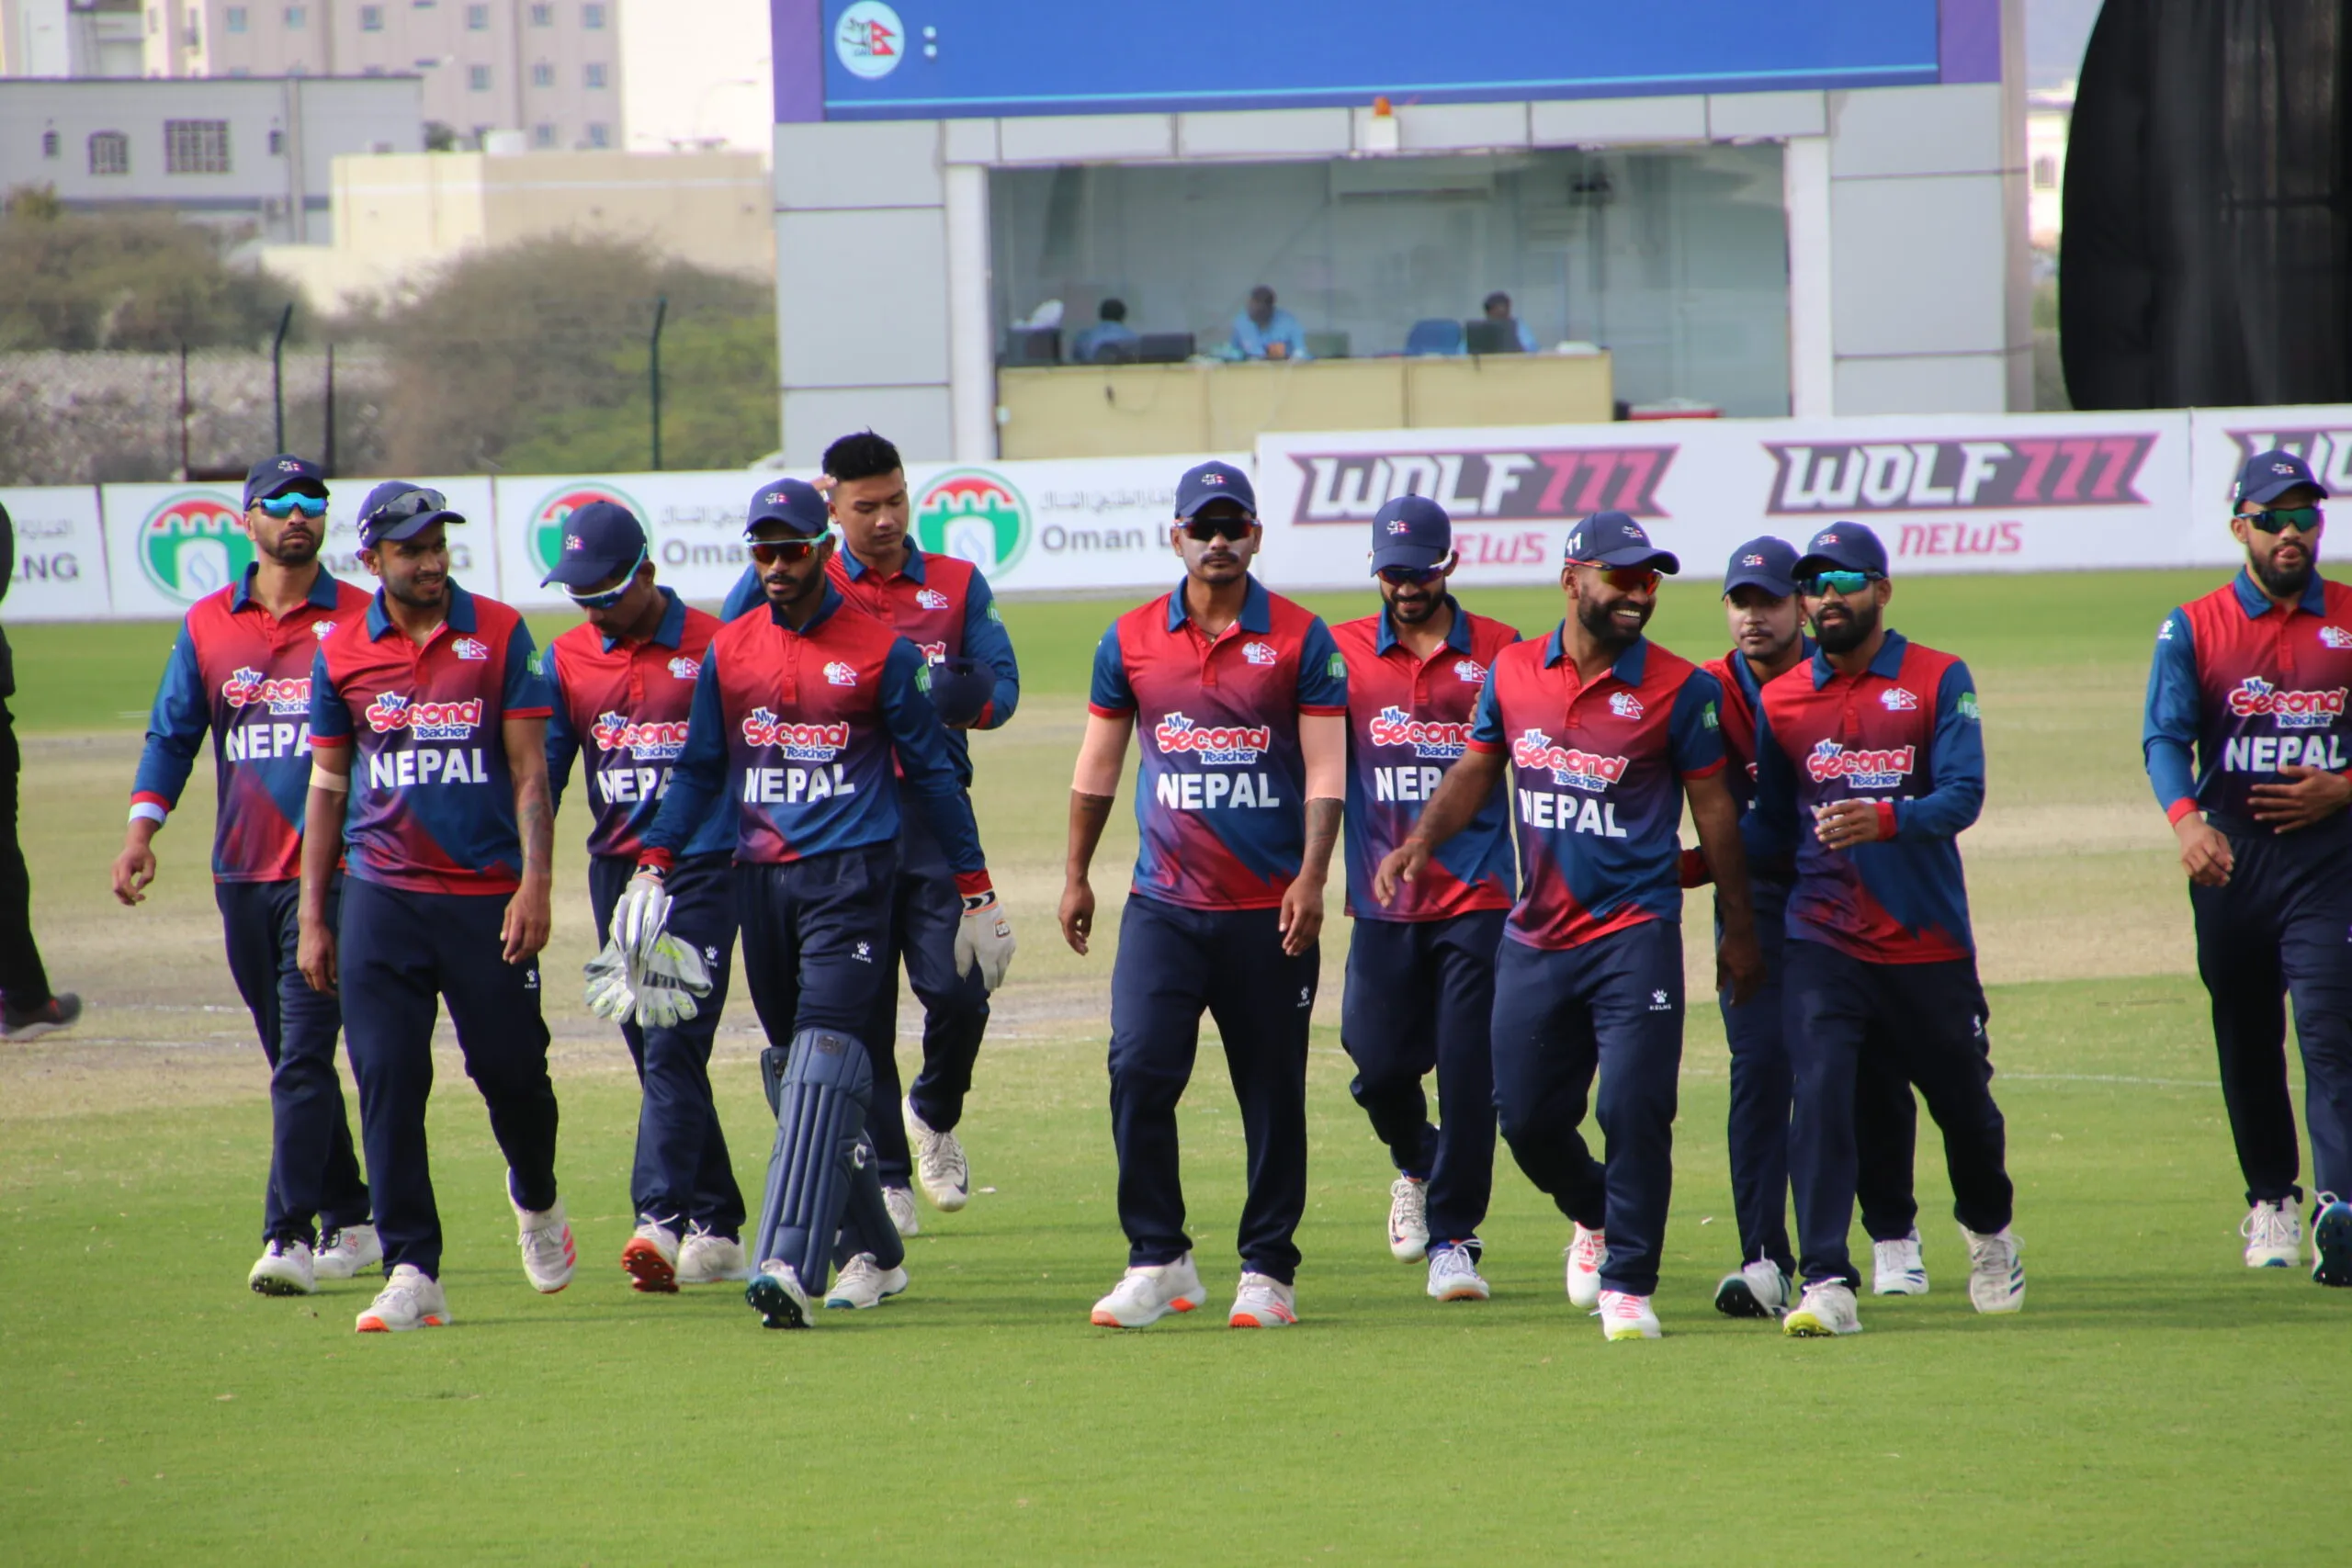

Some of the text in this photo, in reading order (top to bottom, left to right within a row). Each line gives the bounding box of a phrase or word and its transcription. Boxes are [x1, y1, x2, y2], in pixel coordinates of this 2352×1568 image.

[1041, 525, 1144, 552] Oman
[1454, 532, 1548, 565] EWS
[662, 539, 752, 568] Oma
[234, 669, 261, 684] My
[2245, 678, 2272, 695] My
[223, 679, 311, 706] Secon
[378, 693, 405, 709] My
[2230, 687, 2348, 716] Second
[270, 701, 311, 714] Teach
[366, 698, 482, 732] Second
[602, 713, 627, 728] My
[752, 707, 777, 723] My
[1383, 707, 1408, 724] My
[742, 721, 849, 748] Second
[1165, 713, 1193, 730] My
[226, 723, 311, 761] NEPA
[1156, 726, 1270, 753] Second
[1416, 744, 1464, 756] Teache
[1526, 730, 1551, 749] My
[1817, 740, 1841, 756] My
[1514, 739, 1629, 784] Second
[1807, 745, 1916, 782] Second
[2224, 735, 2347, 772] NEPAL
[370, 749, 488, 789] NEPAL
[597, 767, 673, 804] NEPA
[743, 763, 854, 803] NEPAL
[1157, 773, 1280, 809] NEPAL
[1374, 766, 1442, 801] NEP
[1518, 788, 1627, 838] NEPAL
